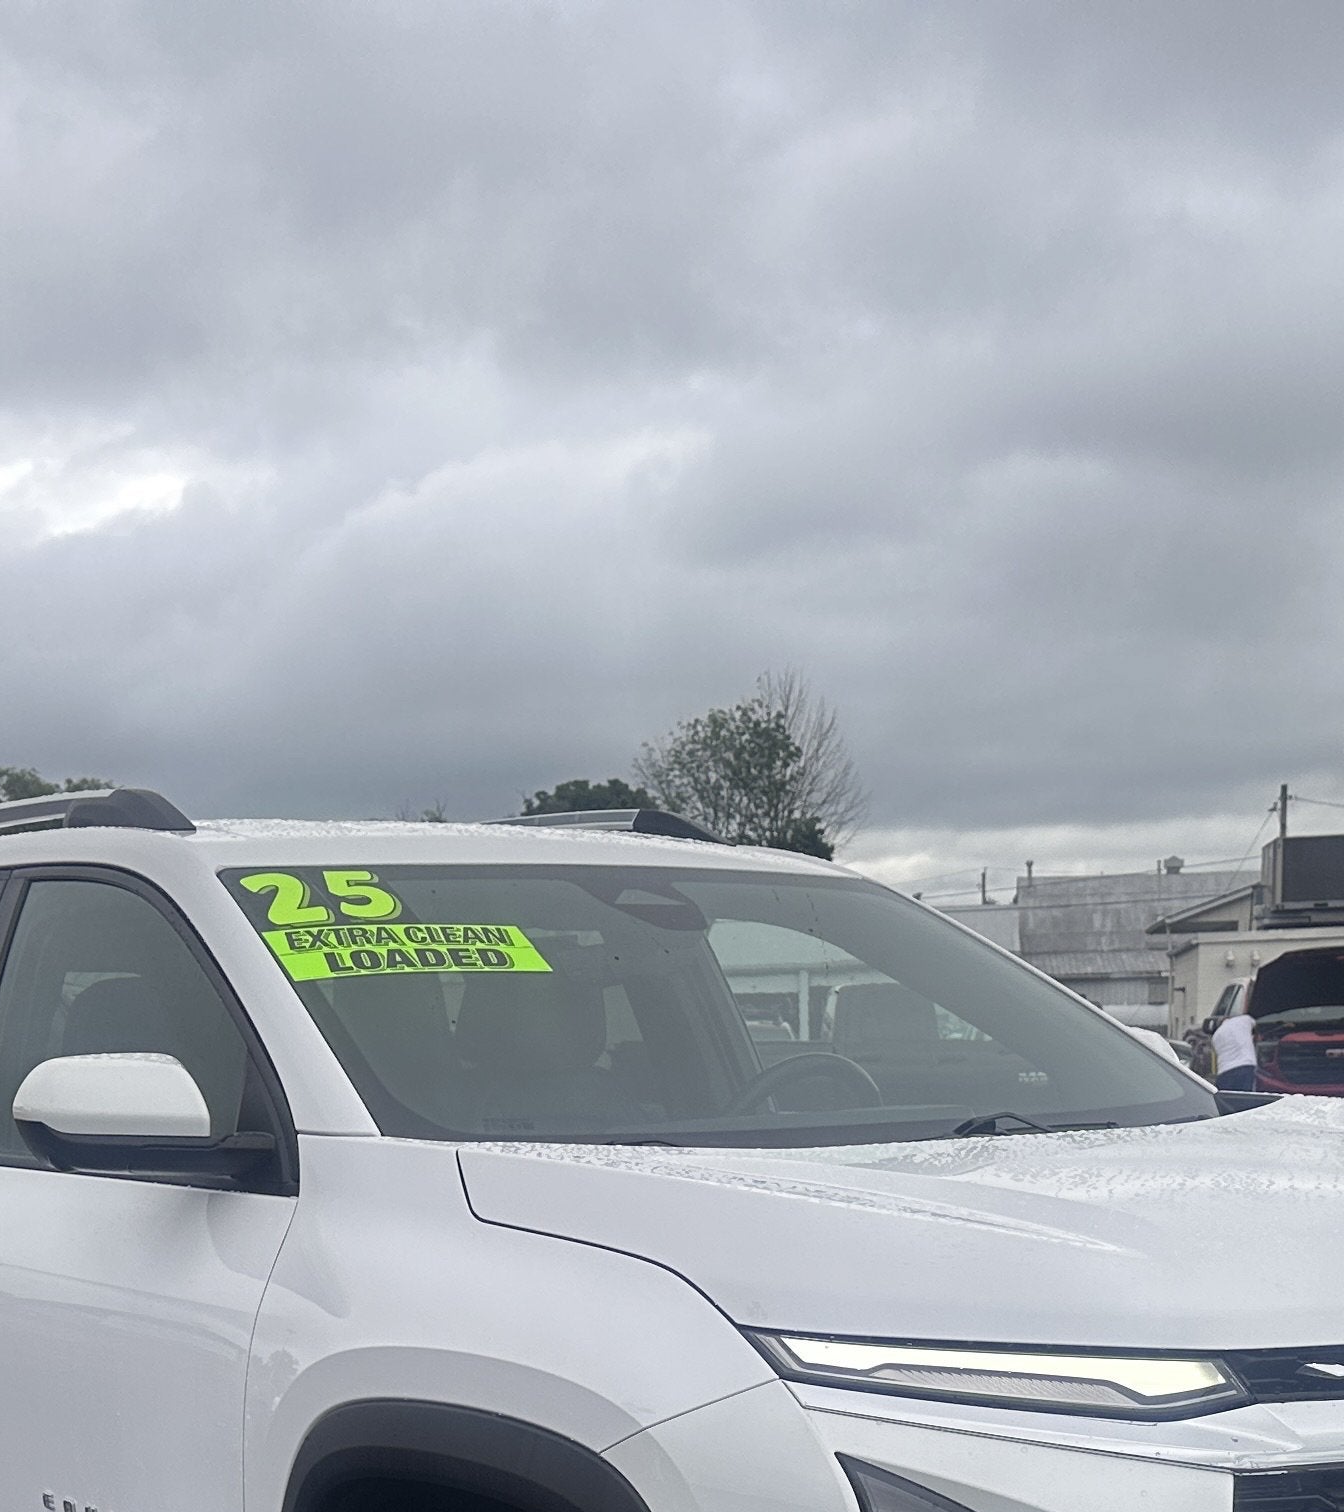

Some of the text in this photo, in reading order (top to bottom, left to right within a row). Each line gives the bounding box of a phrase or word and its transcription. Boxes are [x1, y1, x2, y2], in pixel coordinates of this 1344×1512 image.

[240, 870, 403, 925] 25
[284, 925, 515, 952] EXTRA CLEAN
[328, 947, 514, 974] LOADED
